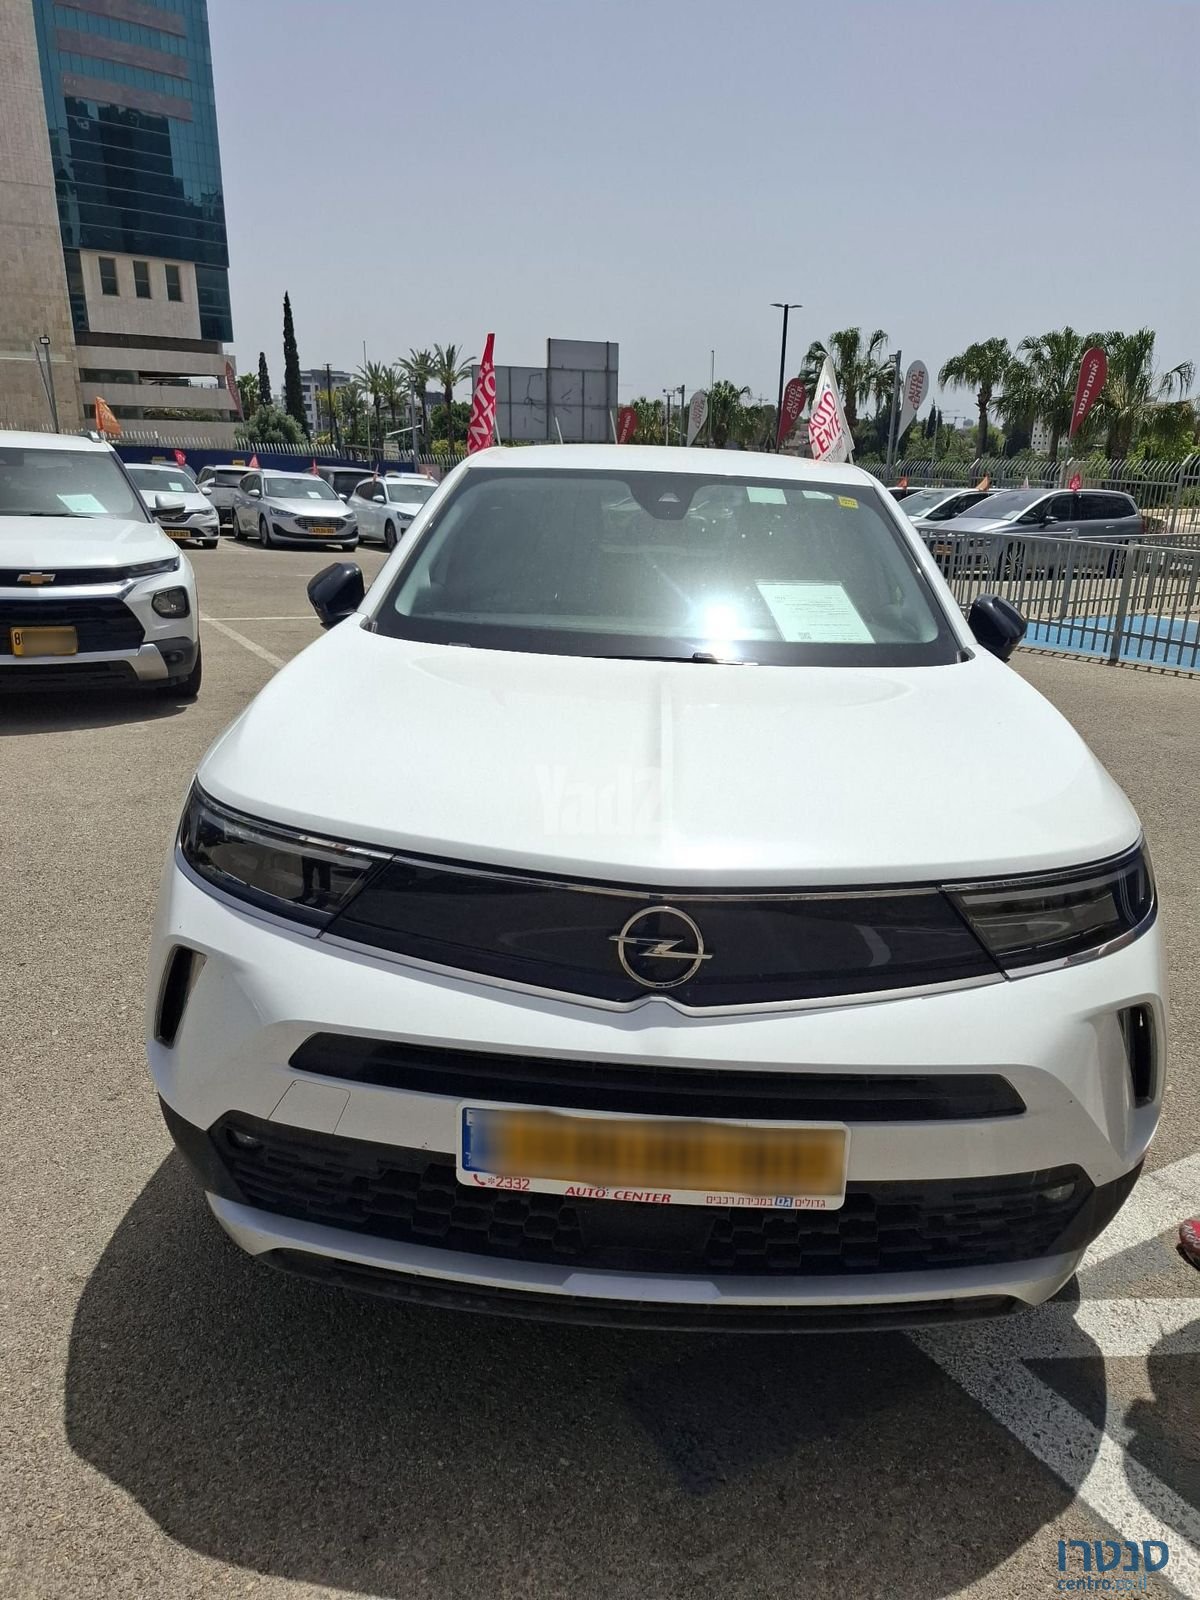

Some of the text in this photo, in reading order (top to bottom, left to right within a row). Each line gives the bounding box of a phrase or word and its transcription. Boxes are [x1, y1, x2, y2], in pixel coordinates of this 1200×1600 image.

[786, 388, 796, 413] AUTO
[790, 385, 804, 420] CENTER
[908, 374, 918, 403] AUTO
[912, 370, 925, 410] CENTER
[1076, 364, 1099, 417] אוטו סנטר
[808, 391, 836, 436] AUTO
[565, 1186, 672, 1203] AUTO CENTER
[775, 1197, 792, 1207] גם
